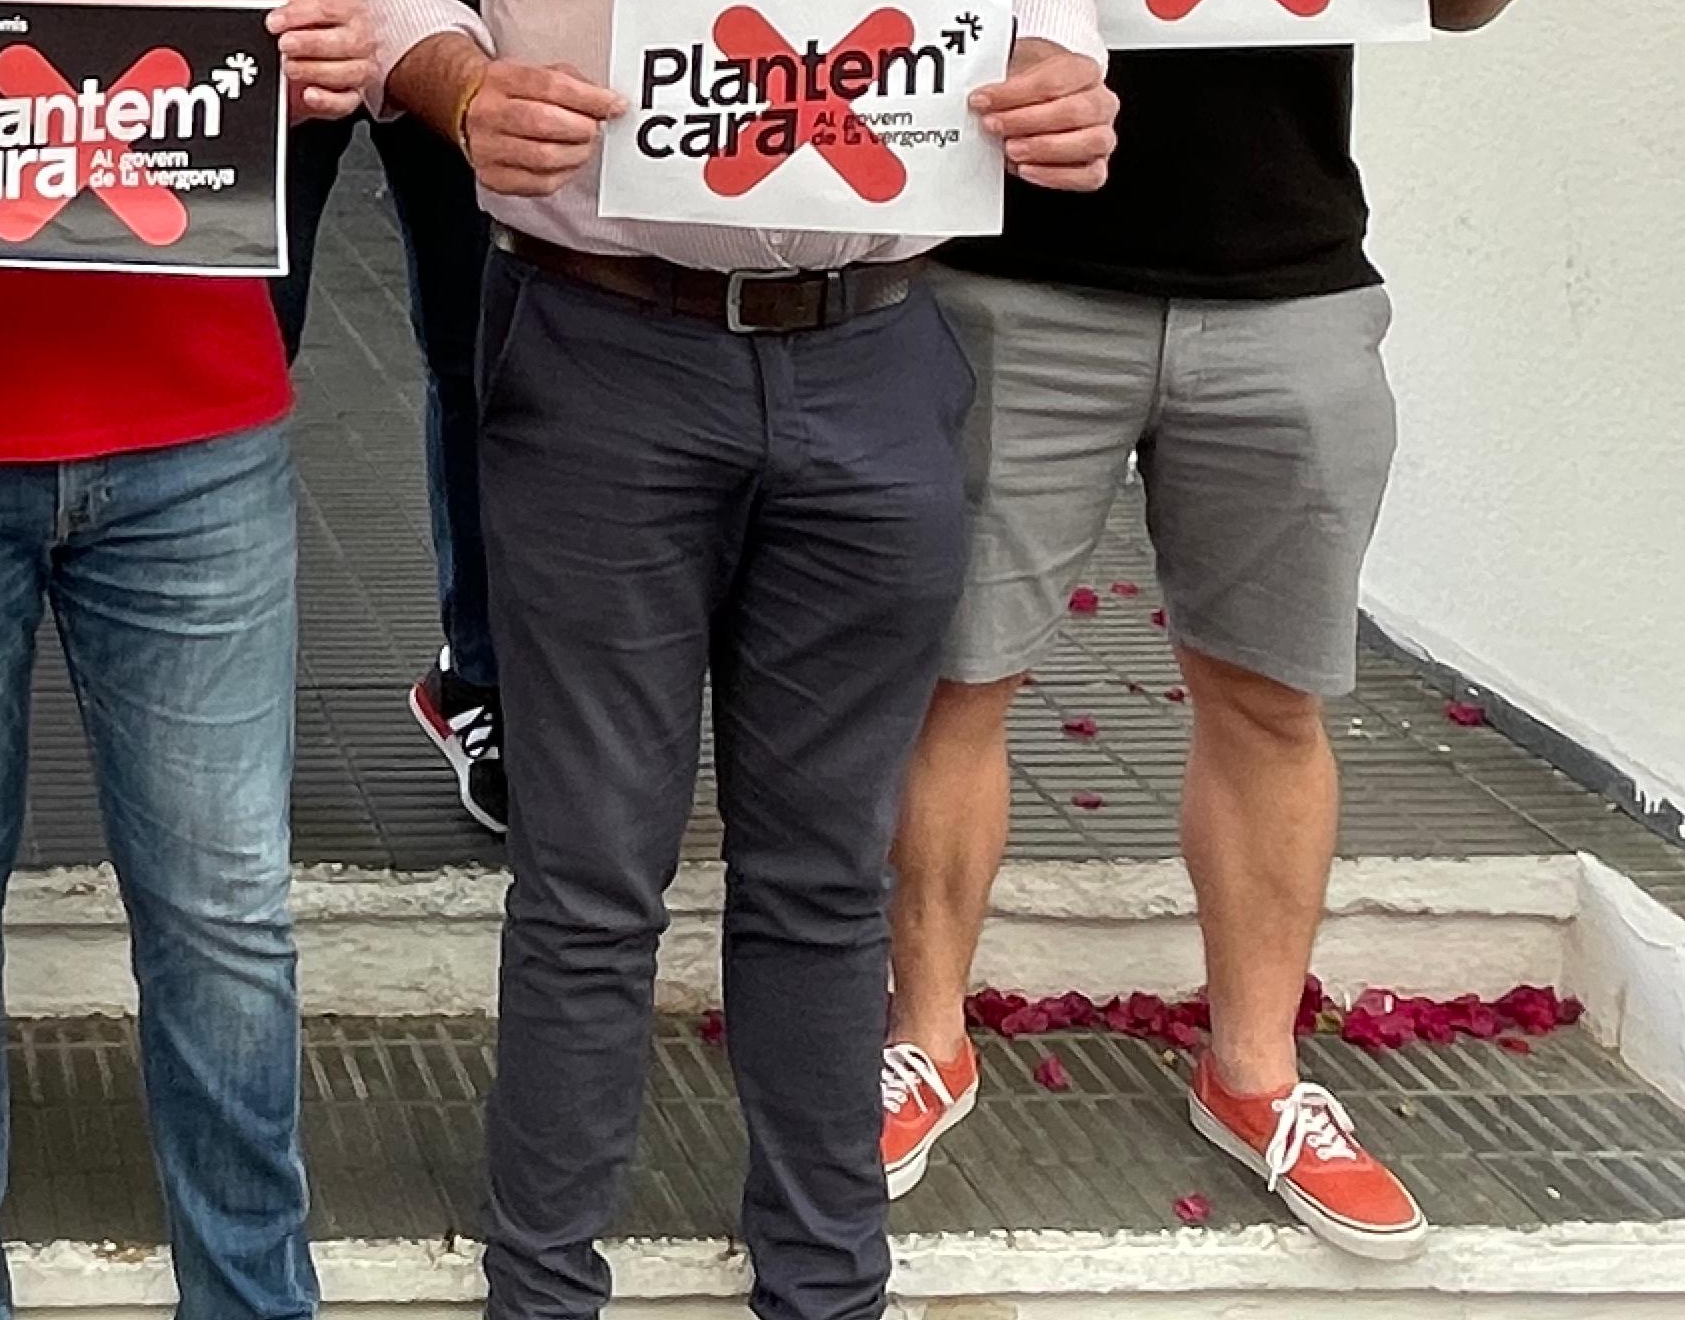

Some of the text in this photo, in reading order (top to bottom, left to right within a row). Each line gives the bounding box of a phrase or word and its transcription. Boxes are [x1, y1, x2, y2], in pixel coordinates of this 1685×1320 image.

[641, 39, 945, 110] Plantem
[637, 108, 798, 159] cara
[815, 110, 835, 127] Al
[90, 151, 112, 168] Al
